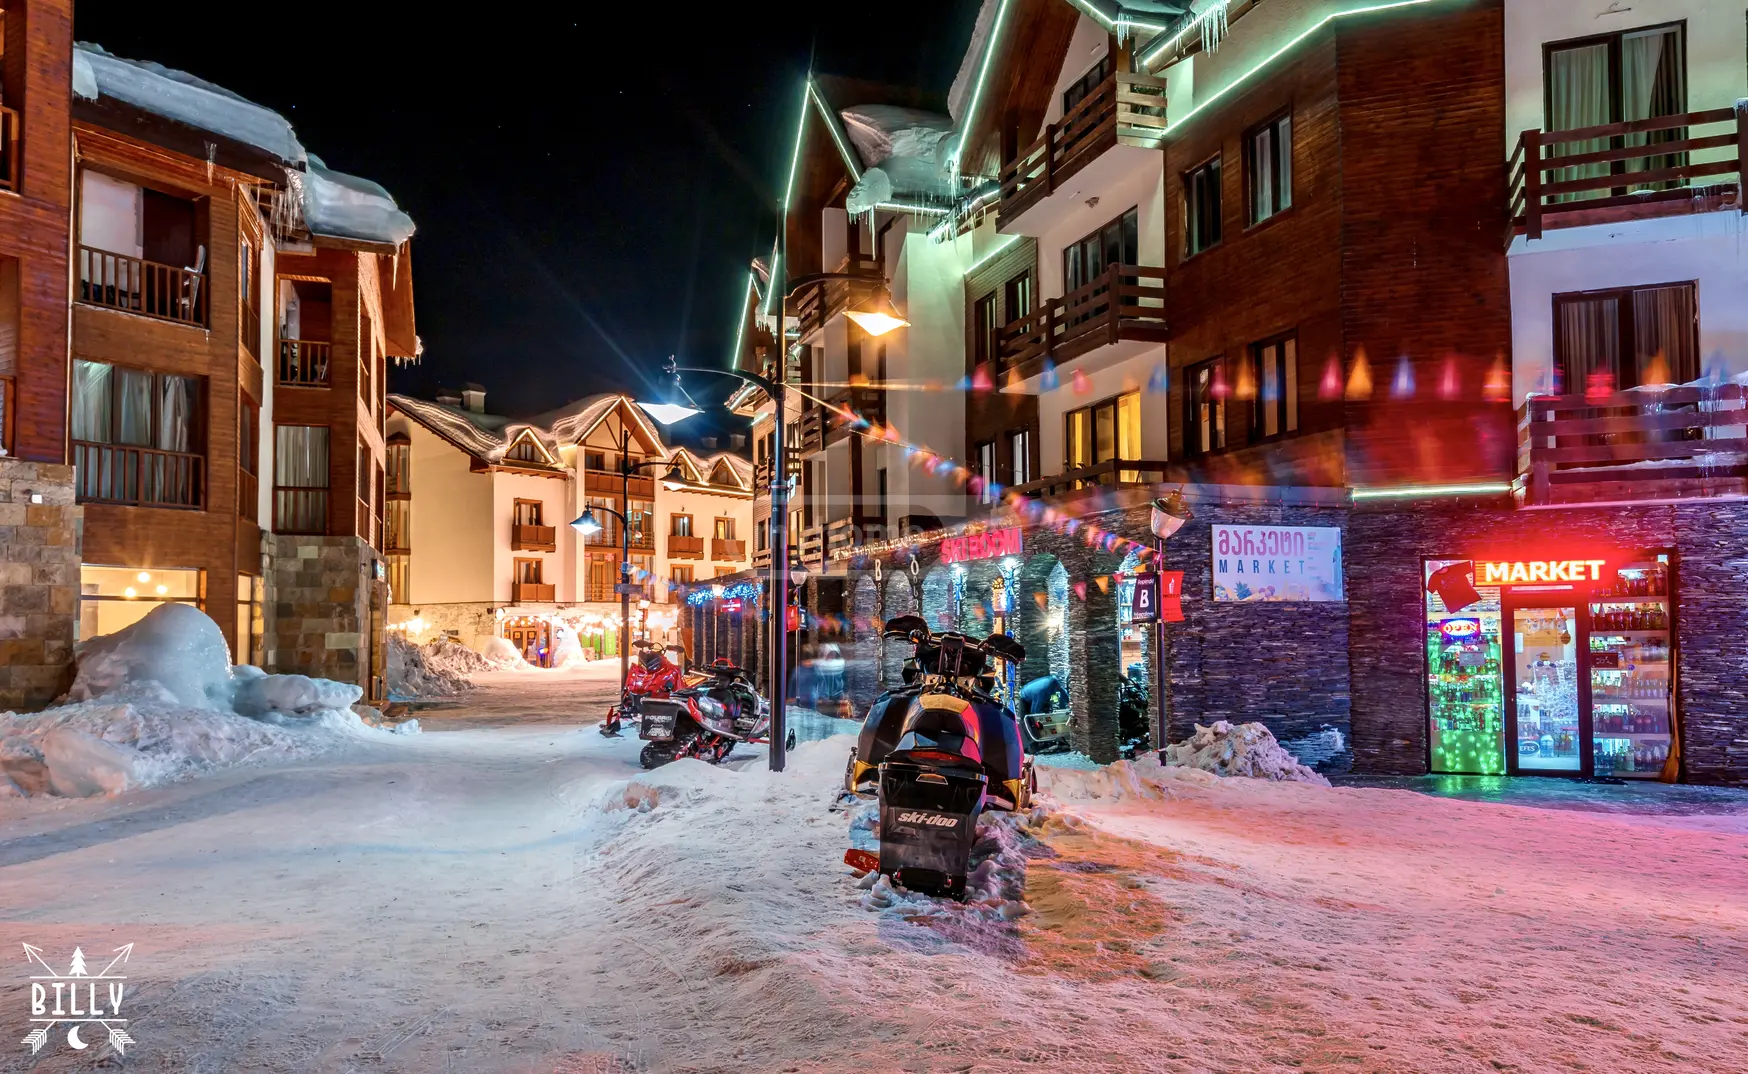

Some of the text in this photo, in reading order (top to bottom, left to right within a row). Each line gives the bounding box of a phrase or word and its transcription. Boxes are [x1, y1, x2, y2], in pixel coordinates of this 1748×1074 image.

[941, 538, 967, 564] SKI
[968, 528, 1020, 560] ROOM
[1218, 529, 1304, 556] მარკეტი
[1219, 559, 1305, 574] MARKET
[1485, 559, 1606, 582] MARKET
[1139, 589, 1150, 608] B
[1442, 623, 1479, 633] OPEN
[897, 811, 959, 828] ski-doo
